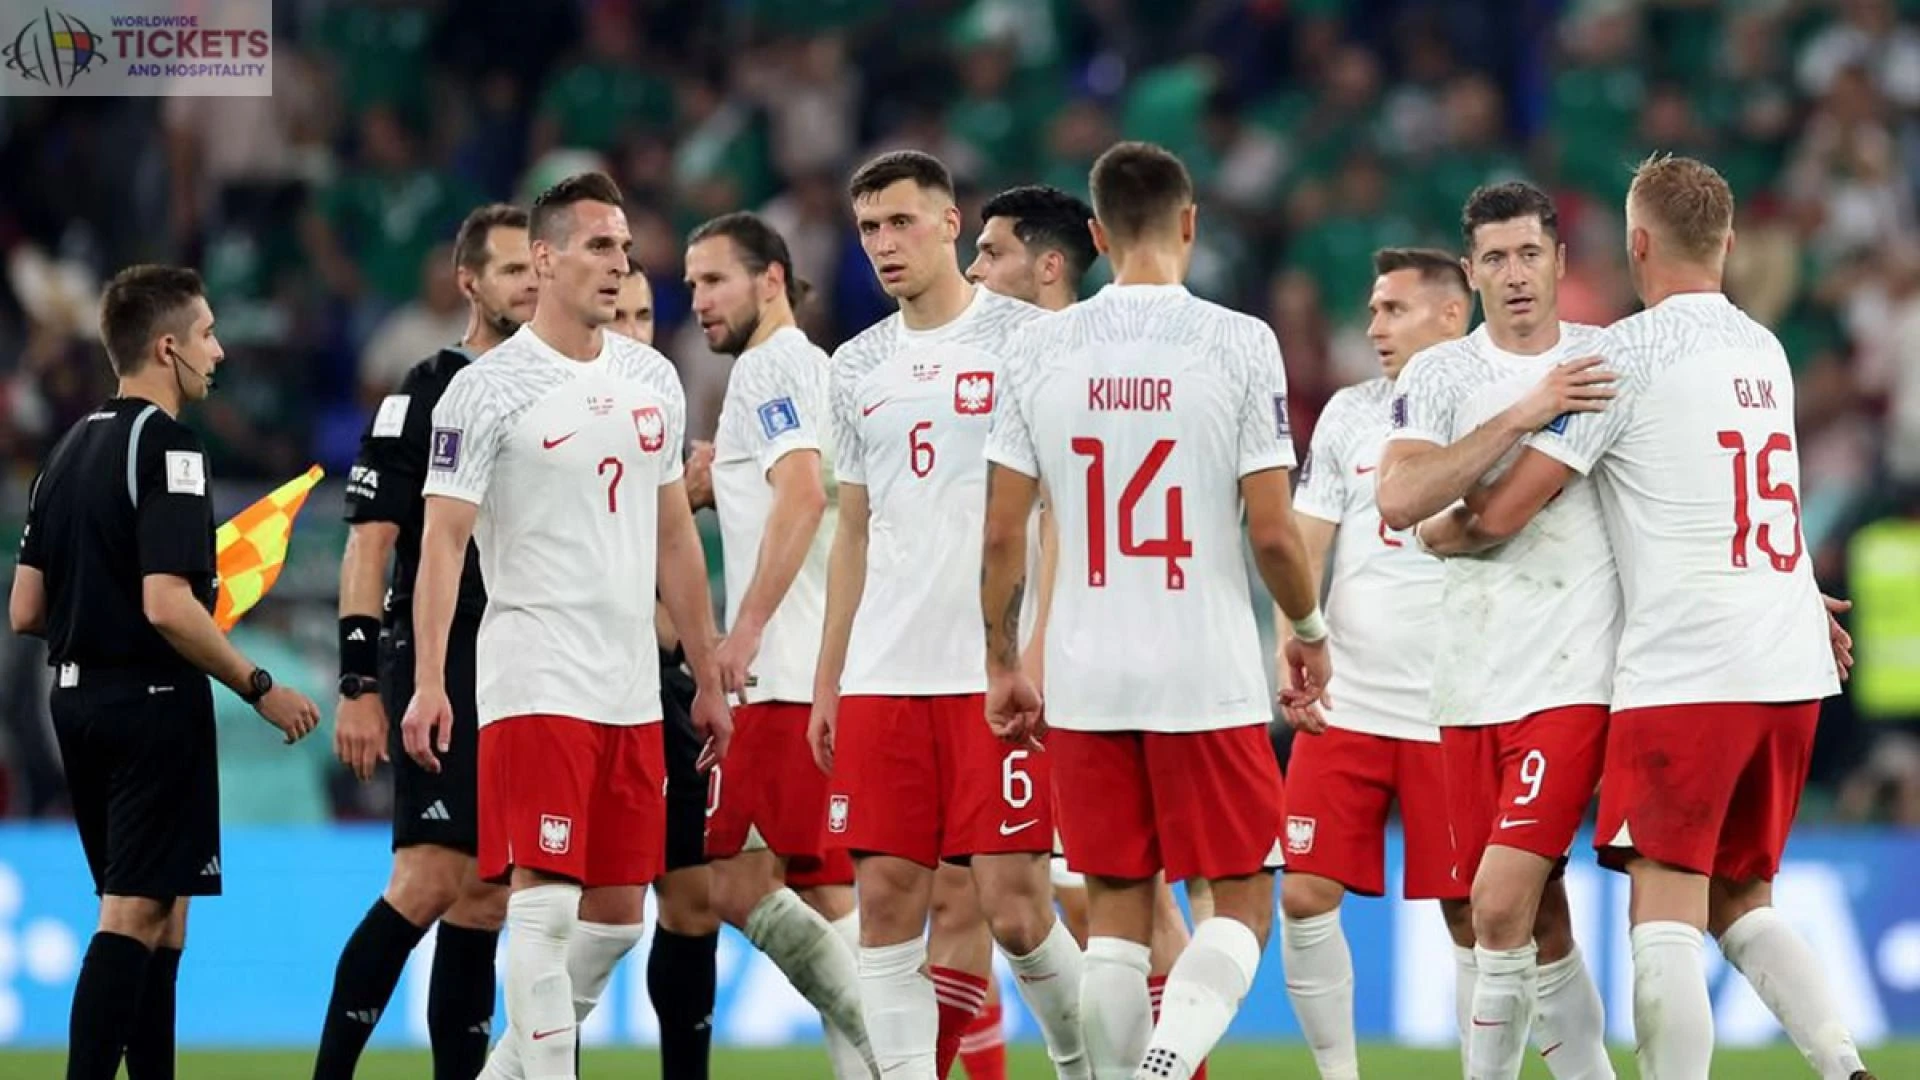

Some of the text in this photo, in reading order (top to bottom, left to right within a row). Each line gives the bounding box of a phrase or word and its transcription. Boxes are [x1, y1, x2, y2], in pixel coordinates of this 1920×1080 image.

[1088, 378, 1172, 411] KIWIOR
[1733, 378, 1777, 408] GLIK
[909, 421, 935, 478] 6
[598, 457, 623, 513] 7
[1716, 430, 1803, 573] 15
[1071, 437, 1192, 590] 14
[1002, 750, 1032, 809] 6
[1513, 749, 1545, 805] 9
